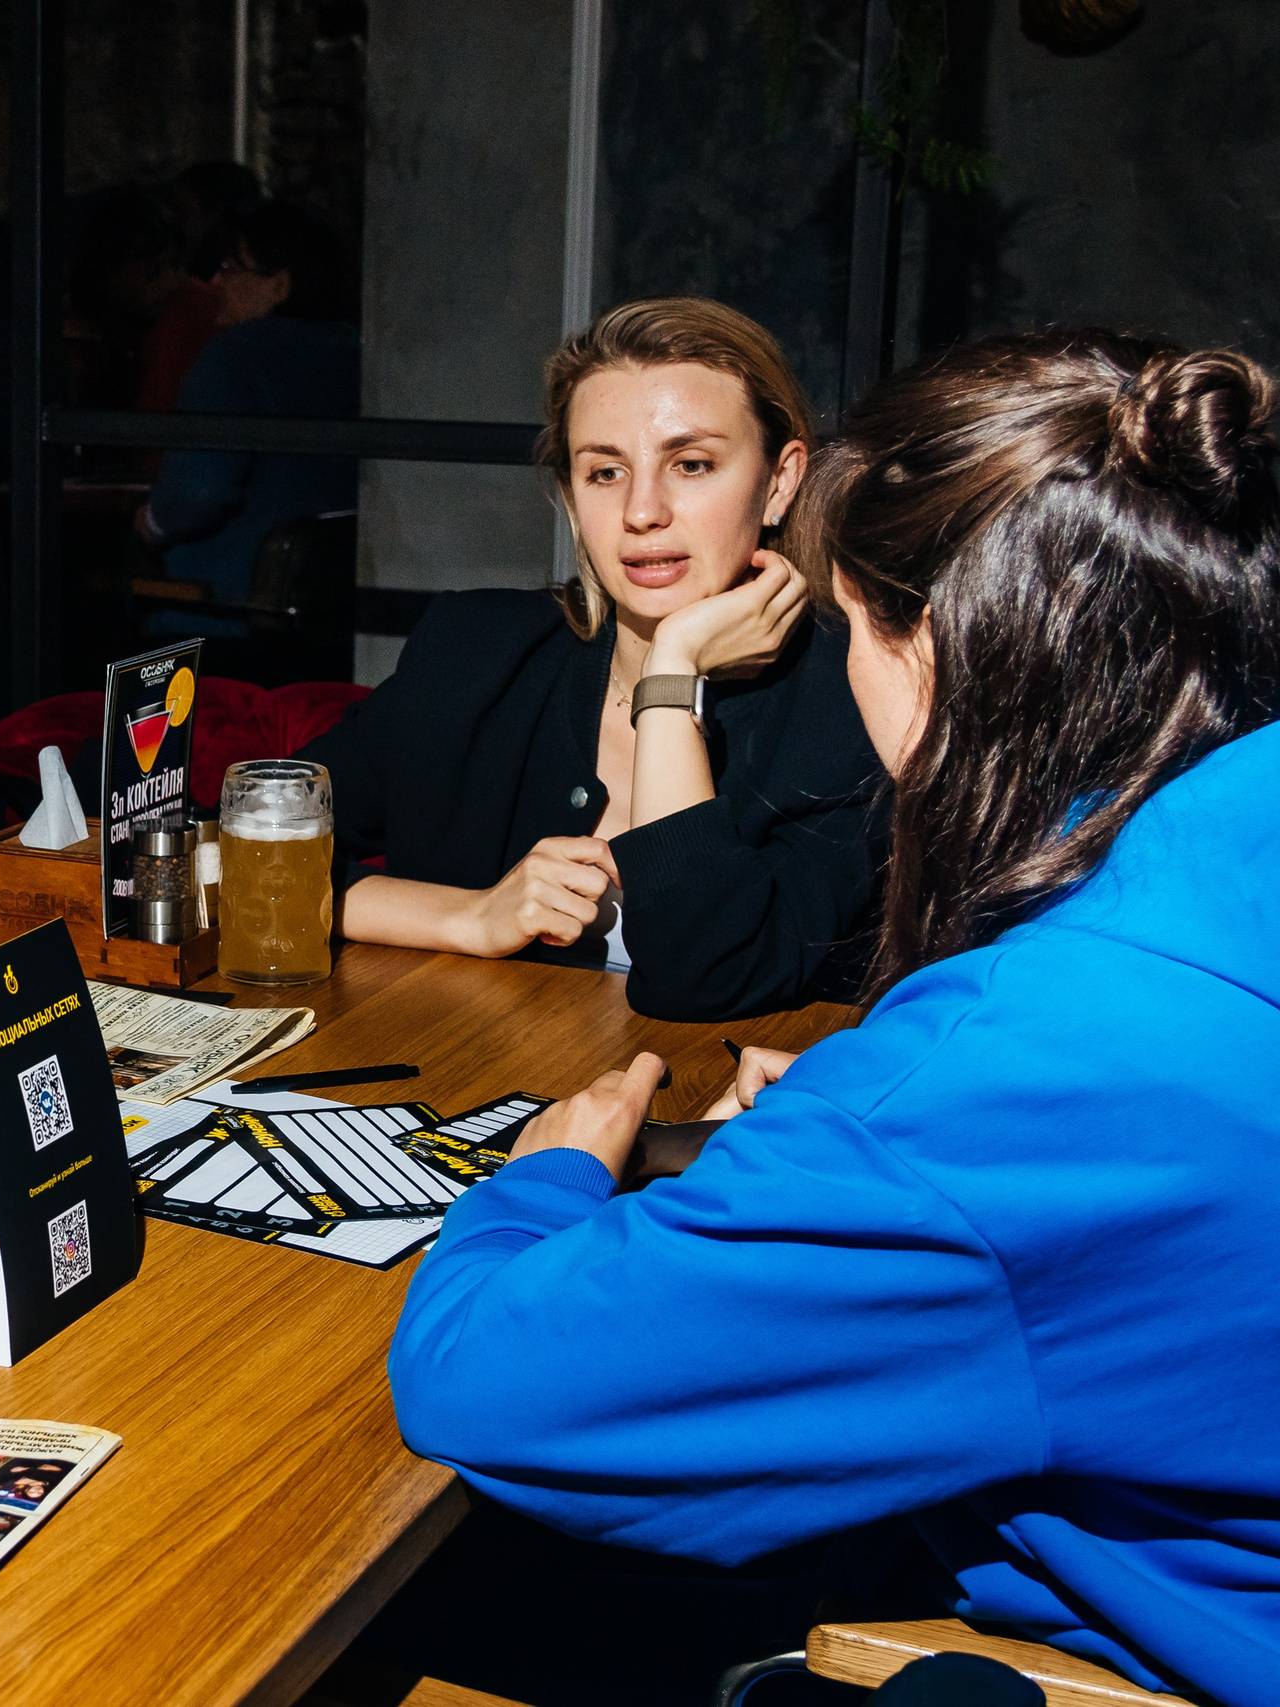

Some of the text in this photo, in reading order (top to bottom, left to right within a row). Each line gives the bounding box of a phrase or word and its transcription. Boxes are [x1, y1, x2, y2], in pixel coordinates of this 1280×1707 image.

[126, 766, 184, 813] КОКТЕЙЛЯ
[110, 818, 130, 844] СТАН
[53, 992, 81, 1018] СЕТЯХ
[29, 1173, 57, 1198] Отсканируй
[61, 1163, 75, 1181] узнай
[74, 1155, 93, 1170] больше
[216, 1209, 244, 1219] 2
[266, 1217, 294, 1227] 3
[15, 1429, 77, 1438] ХМЕЛЬНОЕ
[44, 1443, 85, 1451] ЖИВАЯ
